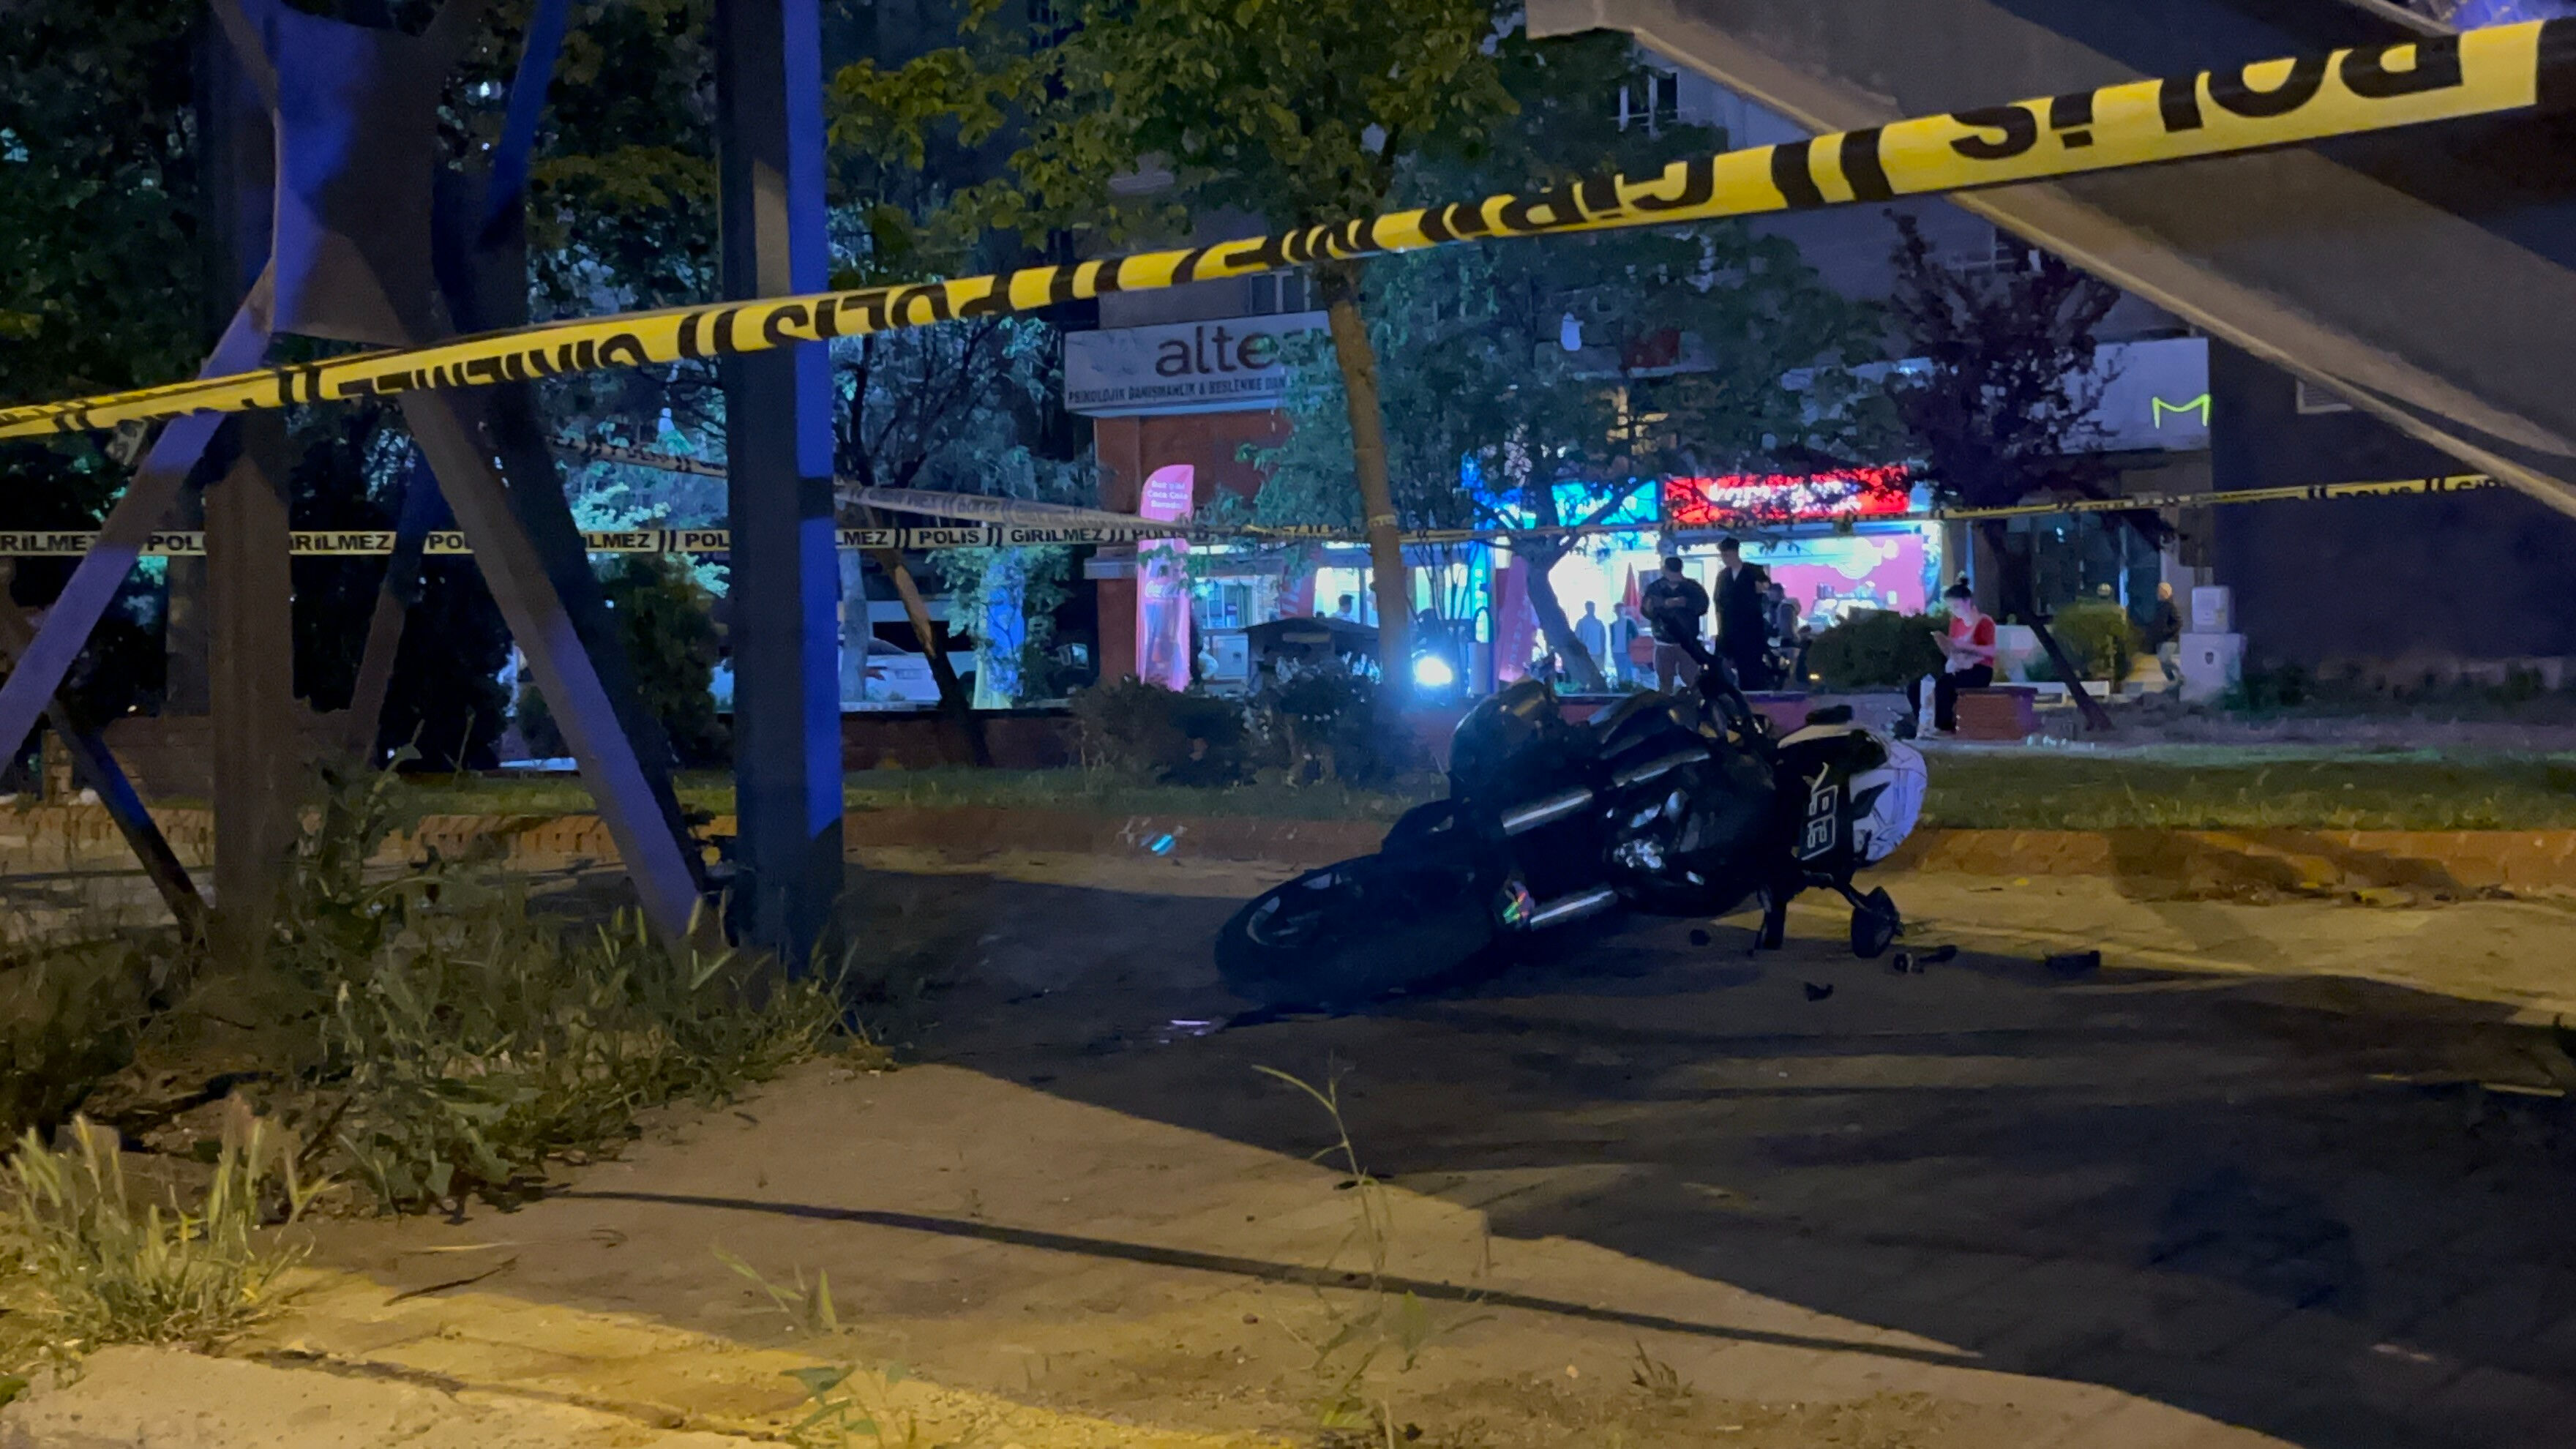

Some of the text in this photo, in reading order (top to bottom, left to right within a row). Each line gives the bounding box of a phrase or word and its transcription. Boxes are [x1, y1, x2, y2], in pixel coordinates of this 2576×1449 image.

[1155, 325, 1281, 378] alte
[0, 534, 97, 551] RILME
[148, 535, 206, 551] POL
[836, 531, 888, 546] MEZ
